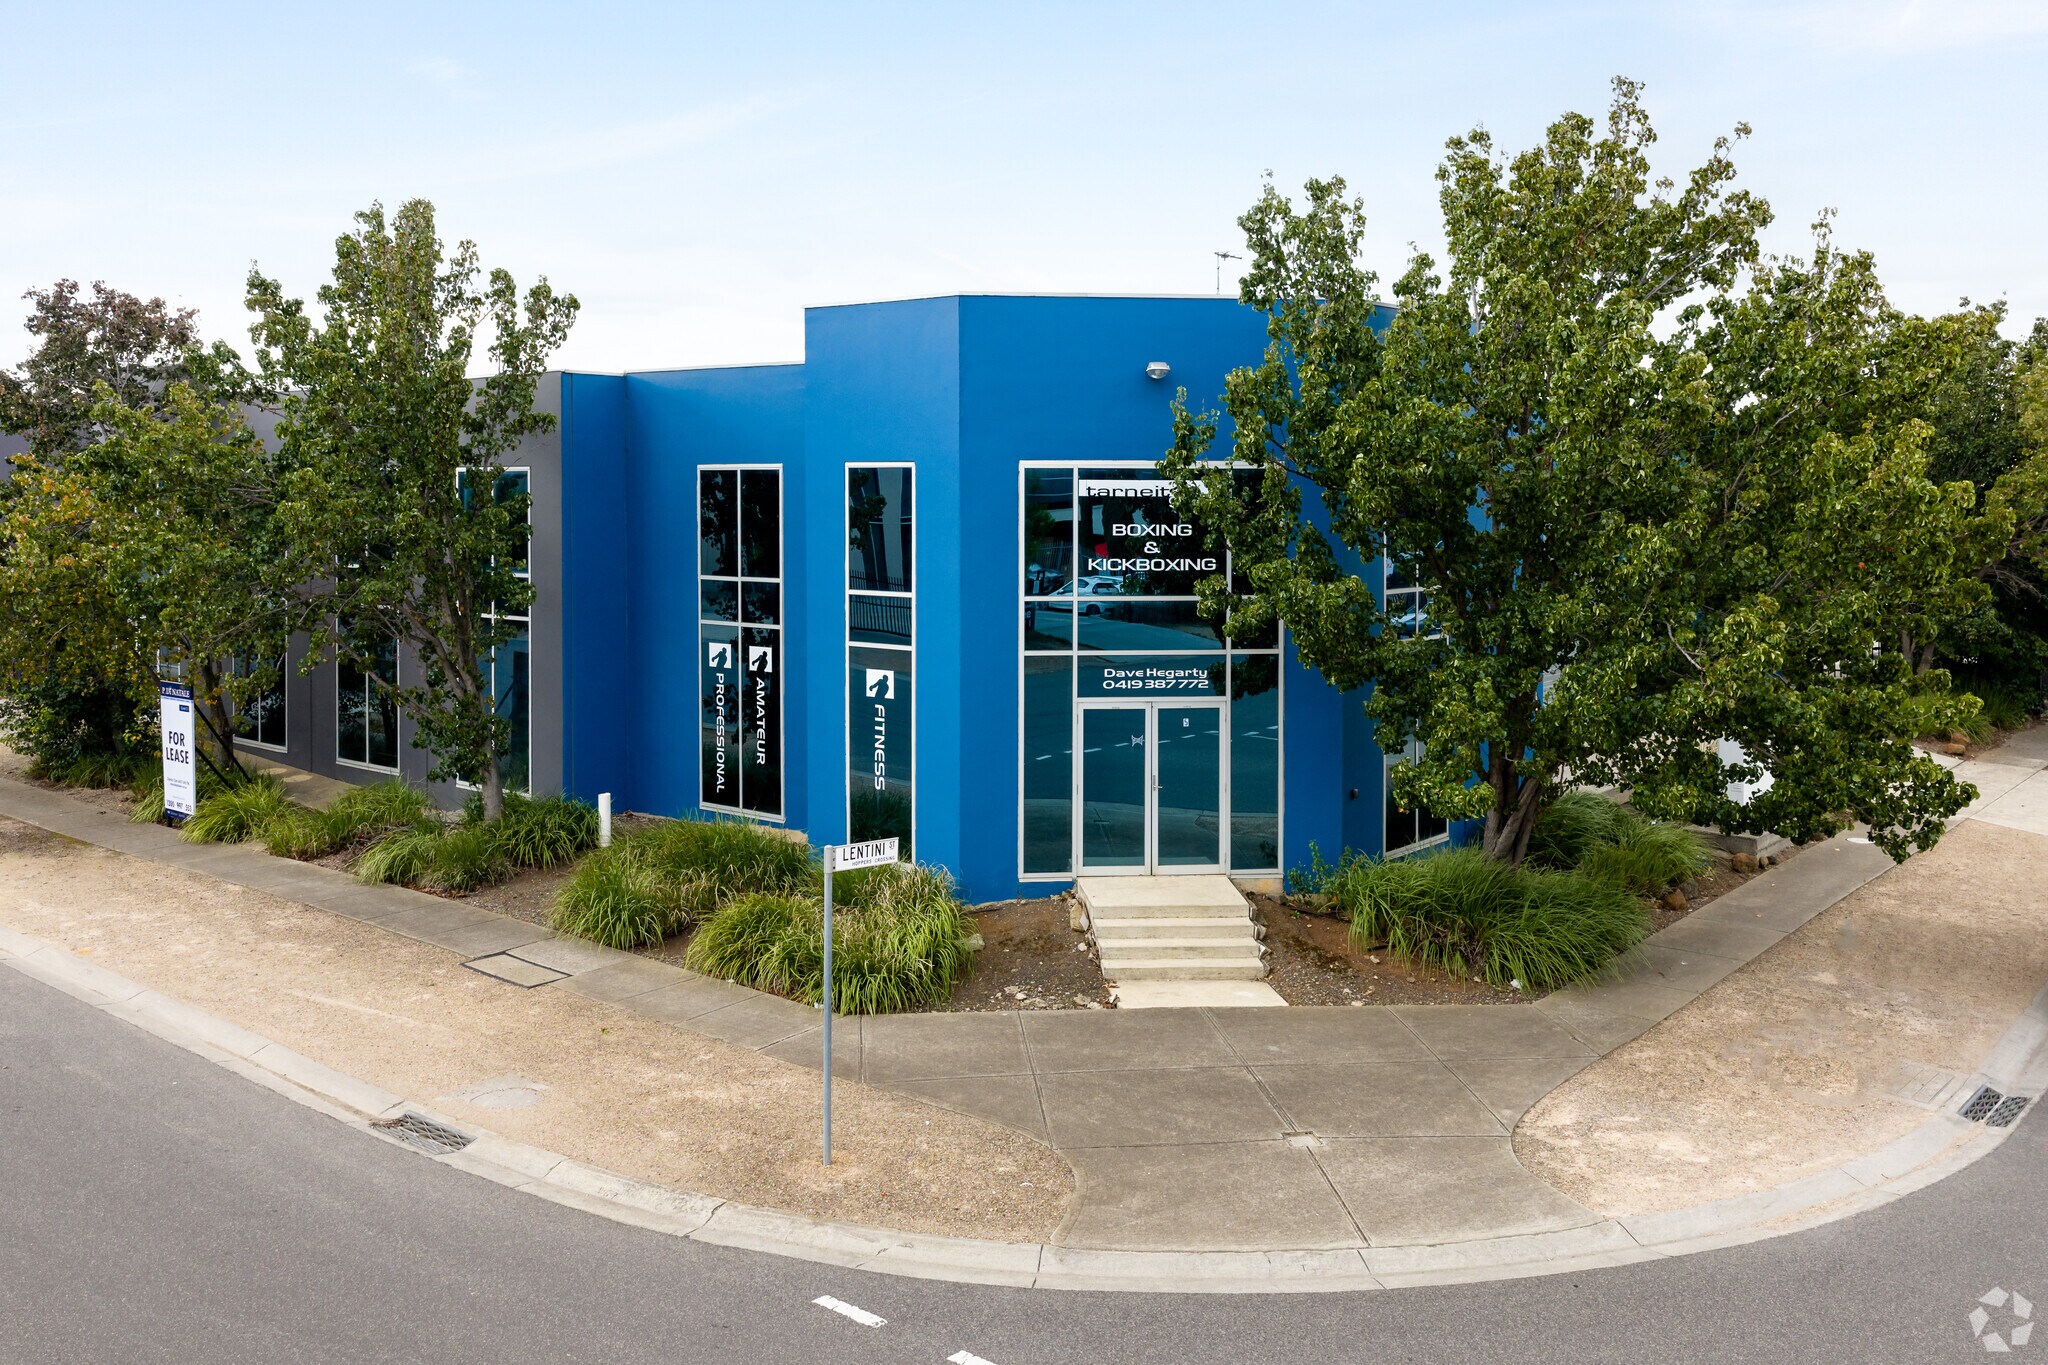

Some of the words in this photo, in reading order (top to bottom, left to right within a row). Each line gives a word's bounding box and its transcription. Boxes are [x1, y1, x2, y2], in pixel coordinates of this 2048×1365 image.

[1112, 524, 1193, 537] BOXING
[1143, 541, 1161, 554] &
[1087, 558, 1217, 571] KICKBOXING
[1104, 668, 1144, 678] Dave
[1146, 668, 1208, 679] Hegarty
[1102, 680, 1143, 689] 0419
[1144, 679, 1176, 689] 387
[1177, 679, 1209, 689] 772
[756, 677, 766, 765] AMATEUR
[168, 730, 185, 747] FOR
[715, 672, 725, 793] PROFESSIONAL
[874, 704, 886, 791] FITNESS
[165, 747, 189, 765] LEASE
[843, 842, 886, 862] LENTINI
[888, 840, 896, 850] ST
[851, 858, 872, 867] HOPPERS
[874, 855, 896, 863] CROSSING
